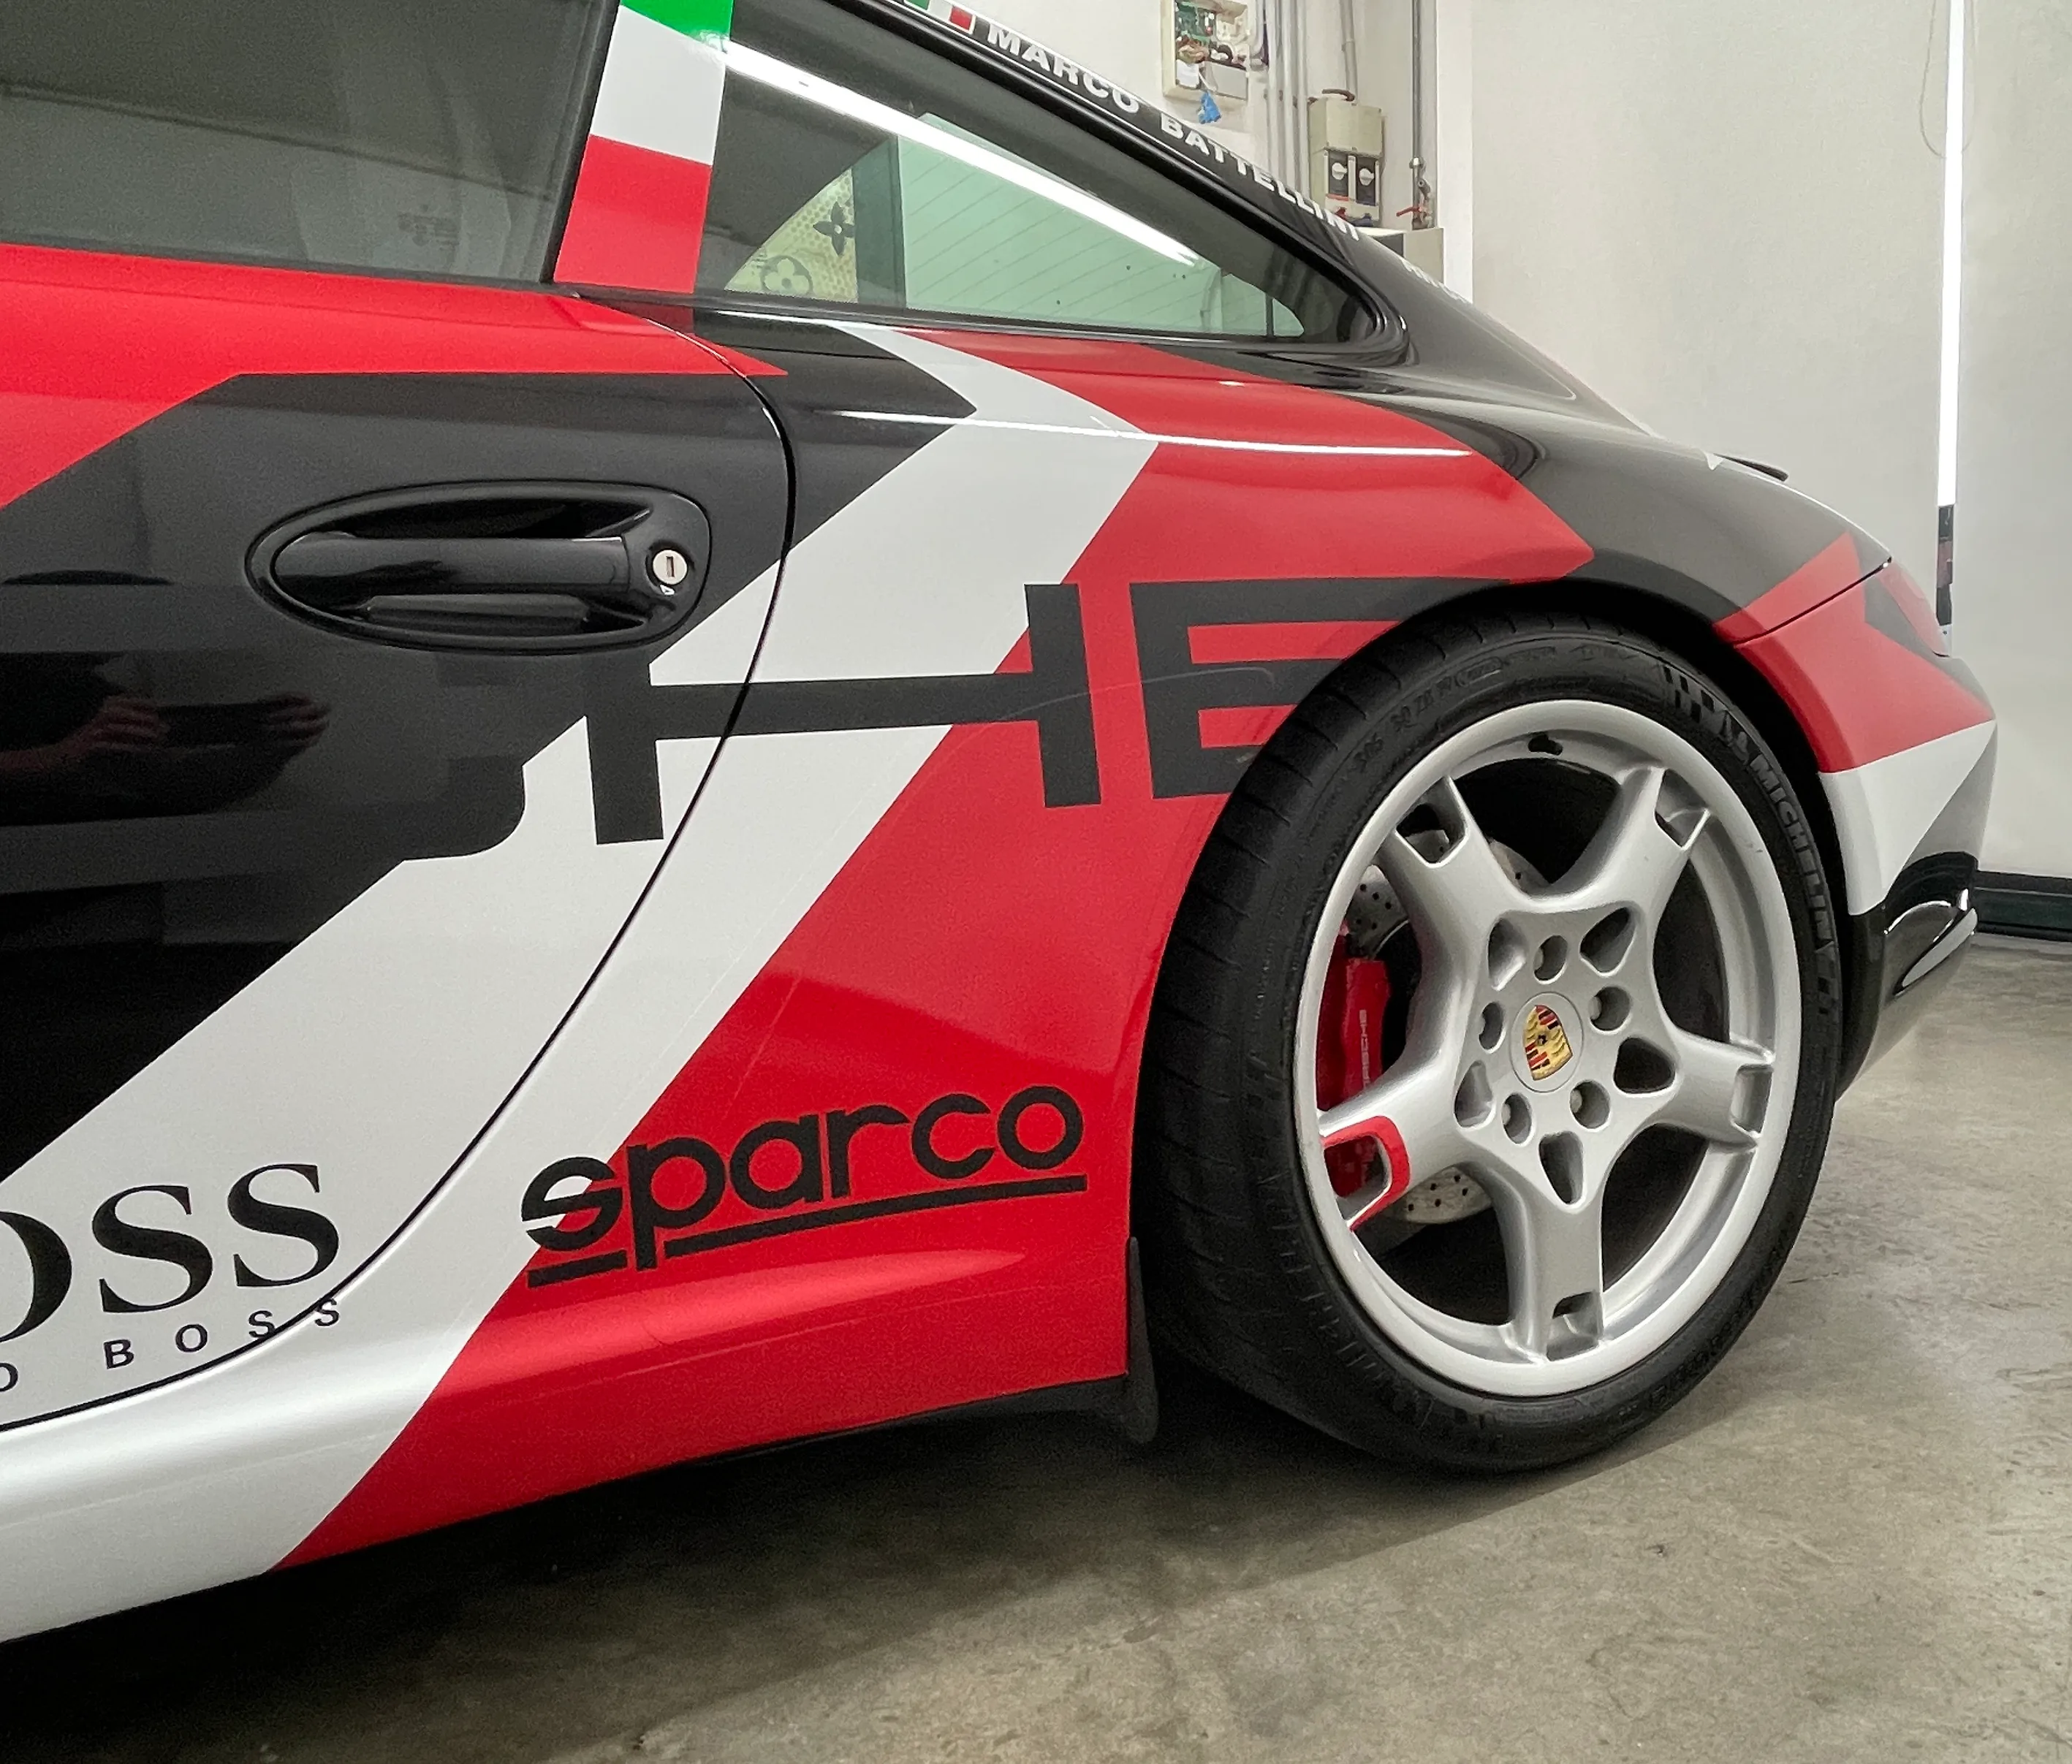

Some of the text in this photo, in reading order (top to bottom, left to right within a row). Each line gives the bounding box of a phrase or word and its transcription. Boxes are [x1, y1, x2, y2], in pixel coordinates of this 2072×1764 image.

[987, 23, 1140, 115] MARCO
[409, 576, 1510, 861] HE
[1750, 754, 1834, 942] MICHELIN
[521, 1085, 1085, 1270] sparco
[103, 1298, 341, 1369] BOSS
